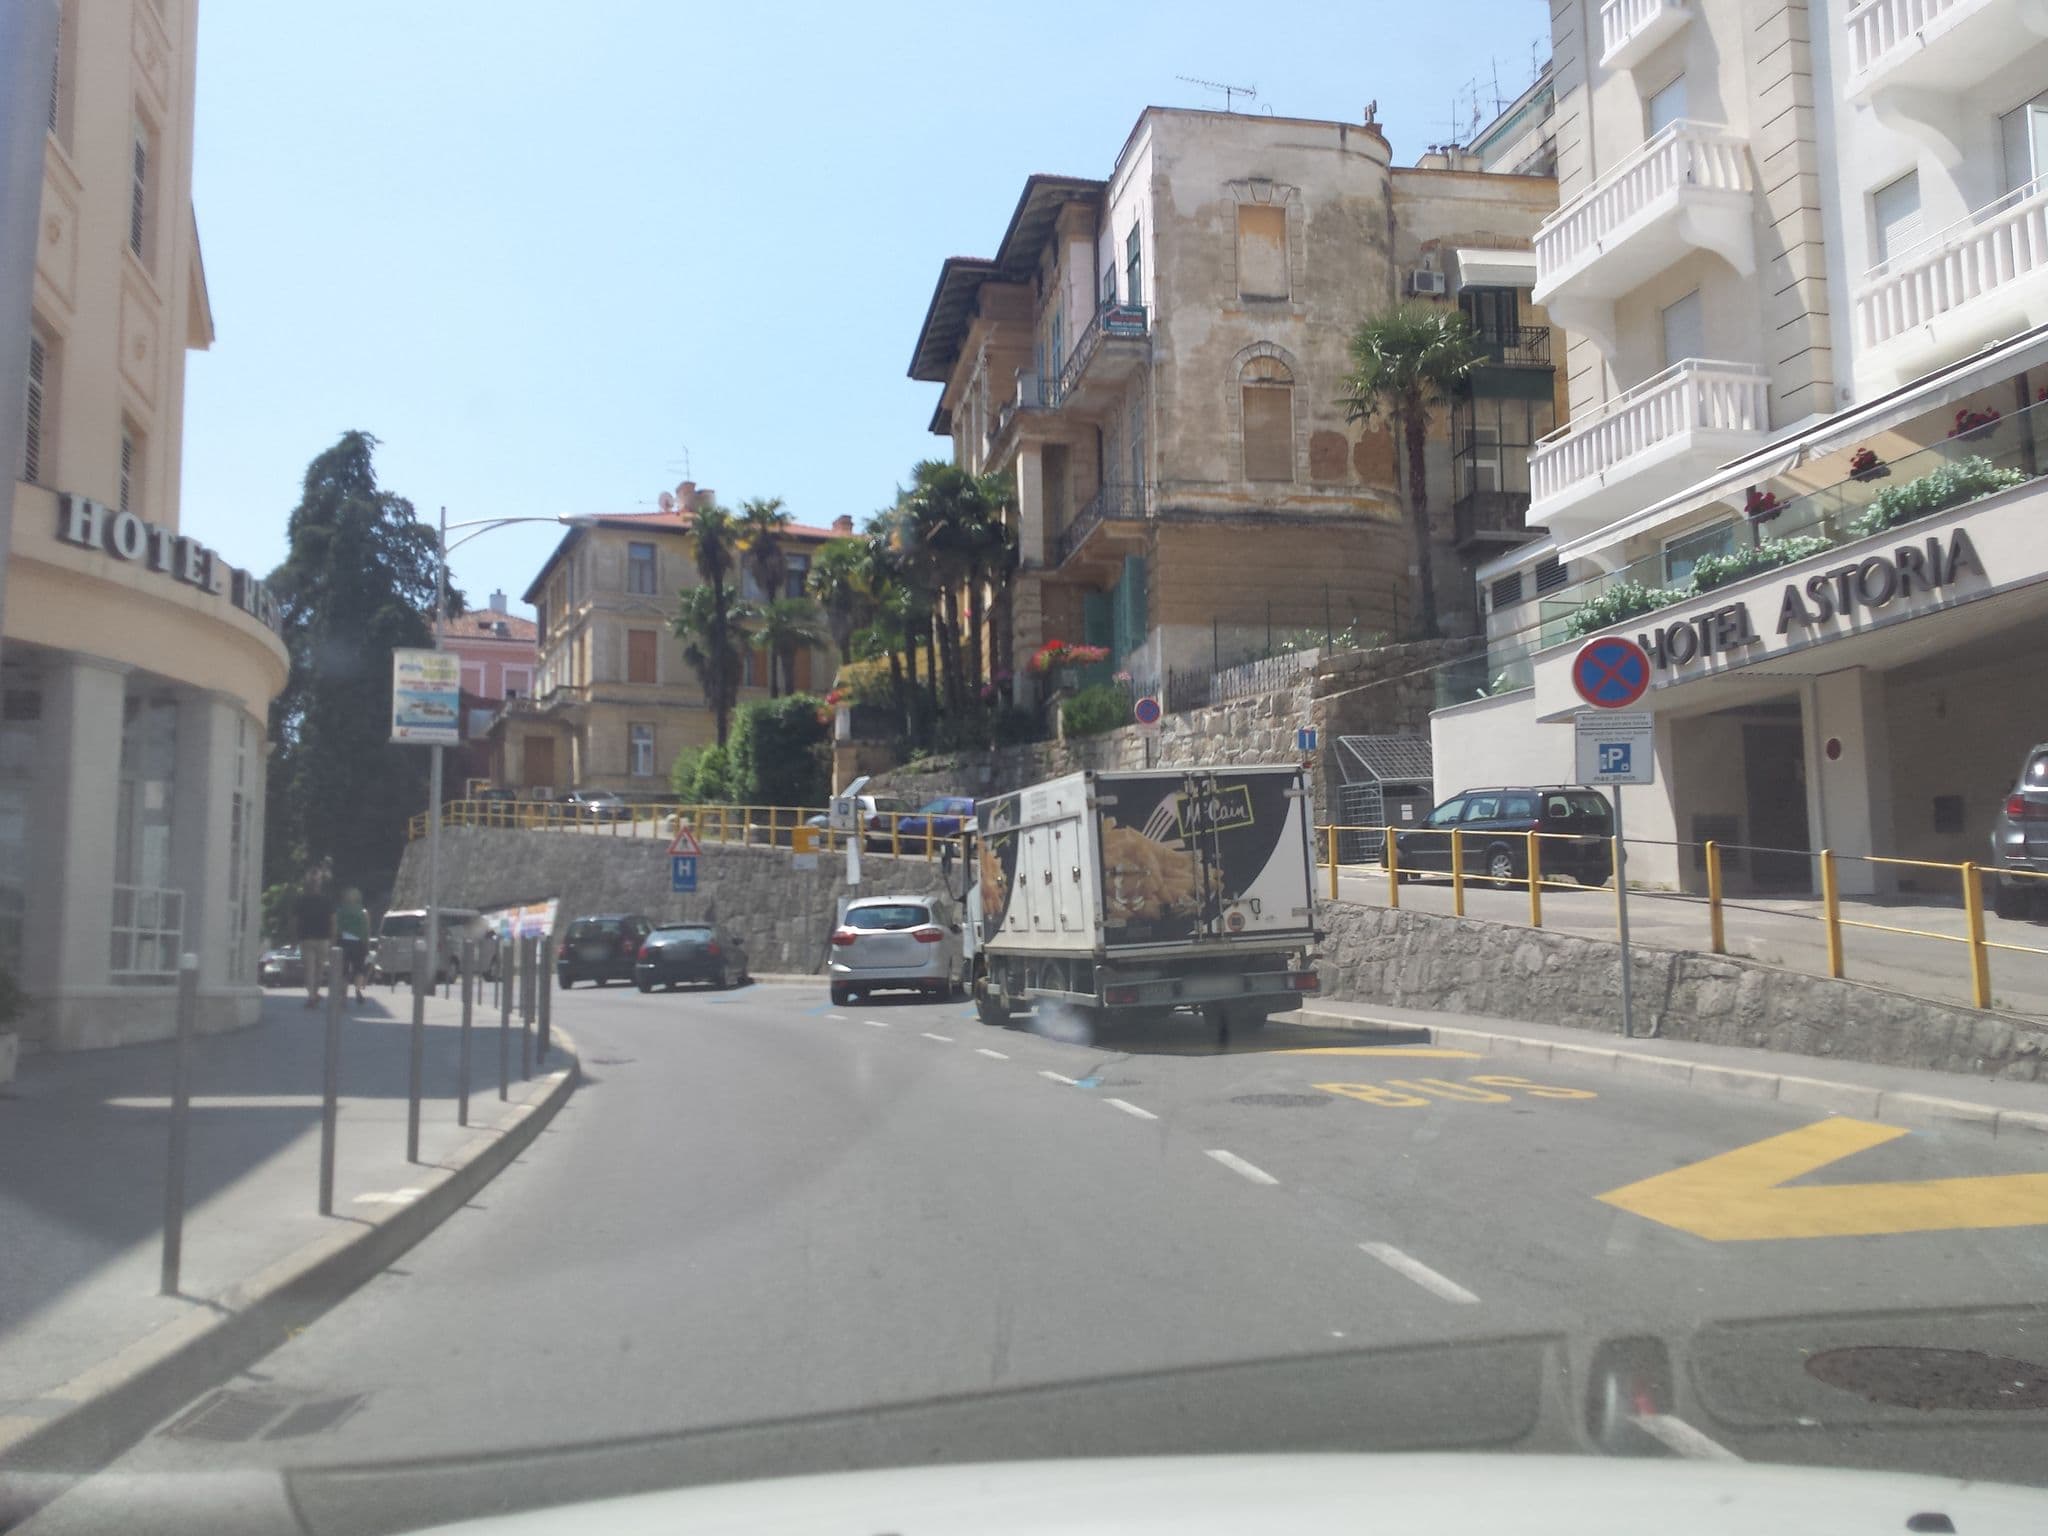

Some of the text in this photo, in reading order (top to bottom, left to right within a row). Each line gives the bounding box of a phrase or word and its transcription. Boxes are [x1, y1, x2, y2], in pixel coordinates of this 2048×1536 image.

[60, 493, 224, 595] HOTEL
[1638, 527, 1987, 669] HOTEL ASTORIA
[1608, 748, 1623, 769] P
[679, 859, 691, 877] H
[1311, 1075, 1599, 1108] BUS
